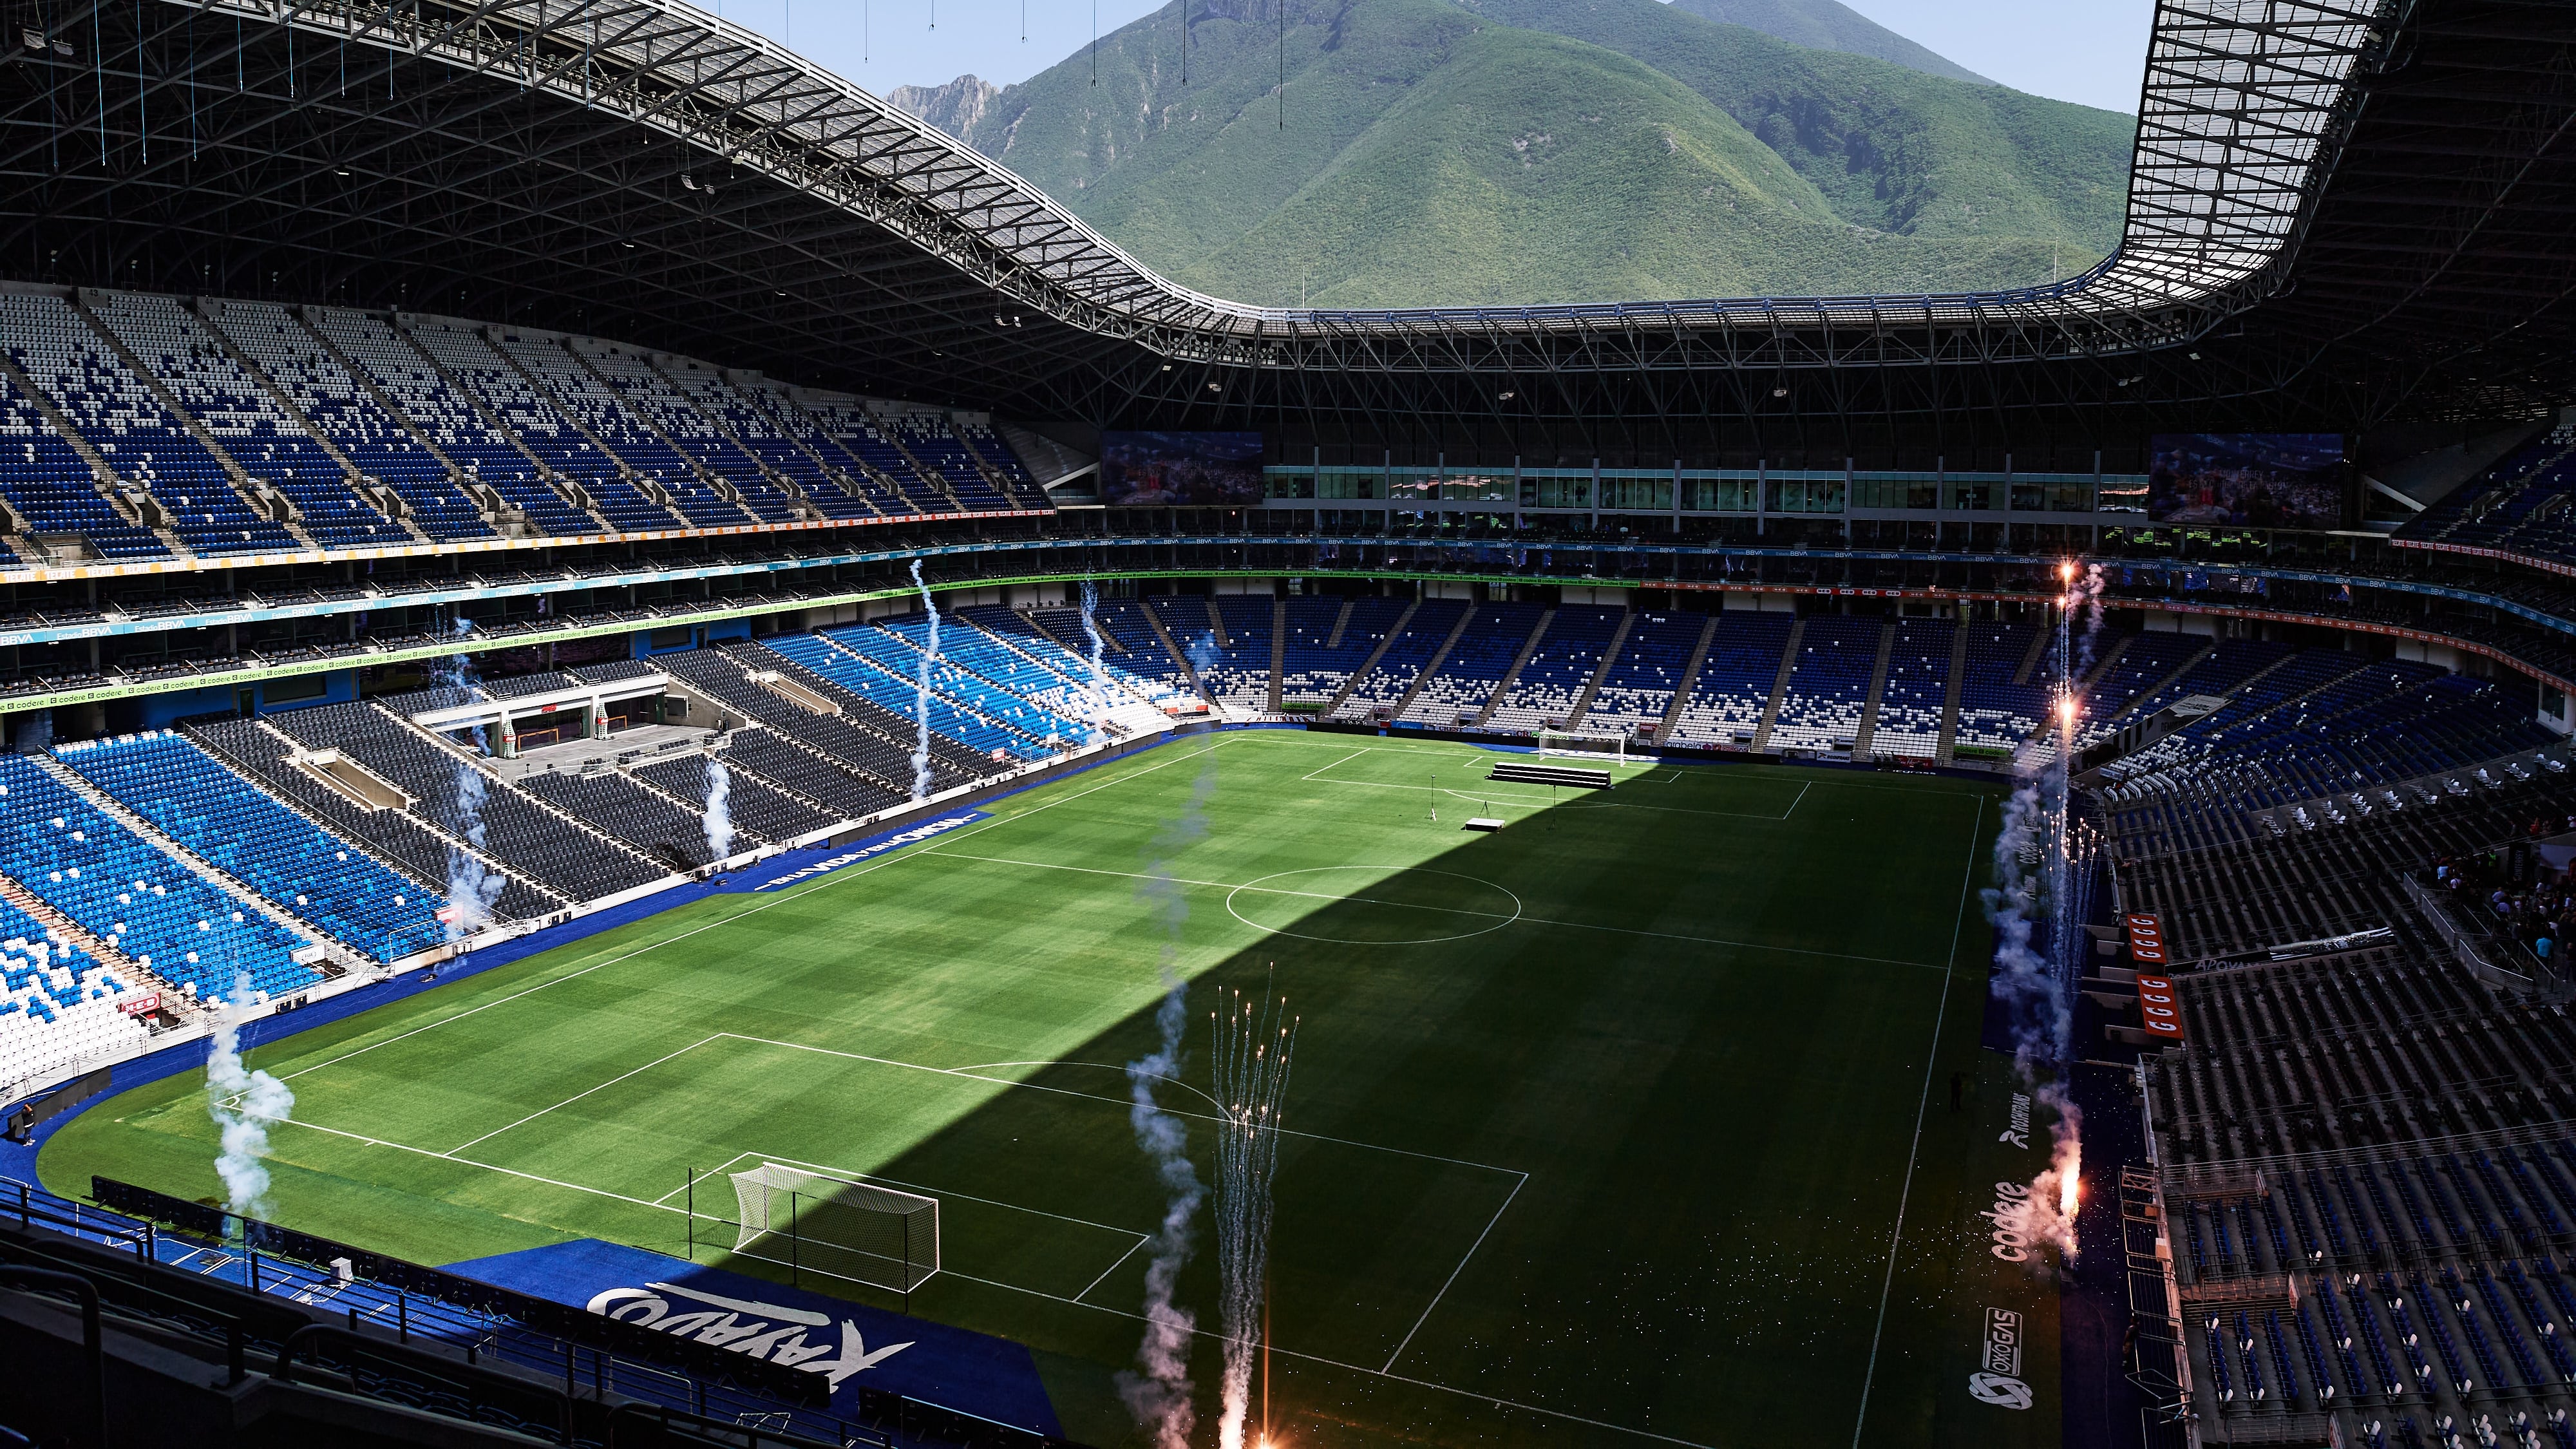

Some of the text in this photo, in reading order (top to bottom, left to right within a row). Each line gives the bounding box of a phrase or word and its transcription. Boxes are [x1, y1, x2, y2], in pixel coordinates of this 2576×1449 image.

[263, 555, 287, 564] TECATE
[296, 553, 318, 562] TECATE
[325, 552, 346, 560] TECATE
[196, 559, 221, 569] TECATE
[231, 557, 255, 566] TECATE
[124, 564, 149, 574] TECATE
[161, 562, 187, 571] TECATE
[45, 569, 75, 579] TECATE
[86, 567, 115, 576] TECATE
[5, 572, 35, 582] TECATE
[511, 586, 529, 594] BBVA
[461, 591, 482, 599] BBVA
[408, 596, 430, 605] BBVA
[352, 601, 374, 610] BBVA
[292, 607, 316, 616] BBVA
[227, 612, 252, 622] BBVA
[157, 619, 185, 629] BBVA
[57, 625, 112, 639] Estadio BBVA
[1, 634, 33, 645] BBVA
[207, 675, 230, 683] codere
[240, 671, 261, 679] codere
[136, 683, 161, 692] codere
[171, 679, 194, 688] codere
[97, 689, 122, 698] codere
[59, 694, 85, 703] codere
[1667, 741, 1701, 750] arabela
[800, 854, 869, 871] VIDA
[893, 818, 971, 841] CANCHA
[2010, 1093, 2031, 1133] ROSHFRANS
[1980, 1181, 2030, 1262] codere
